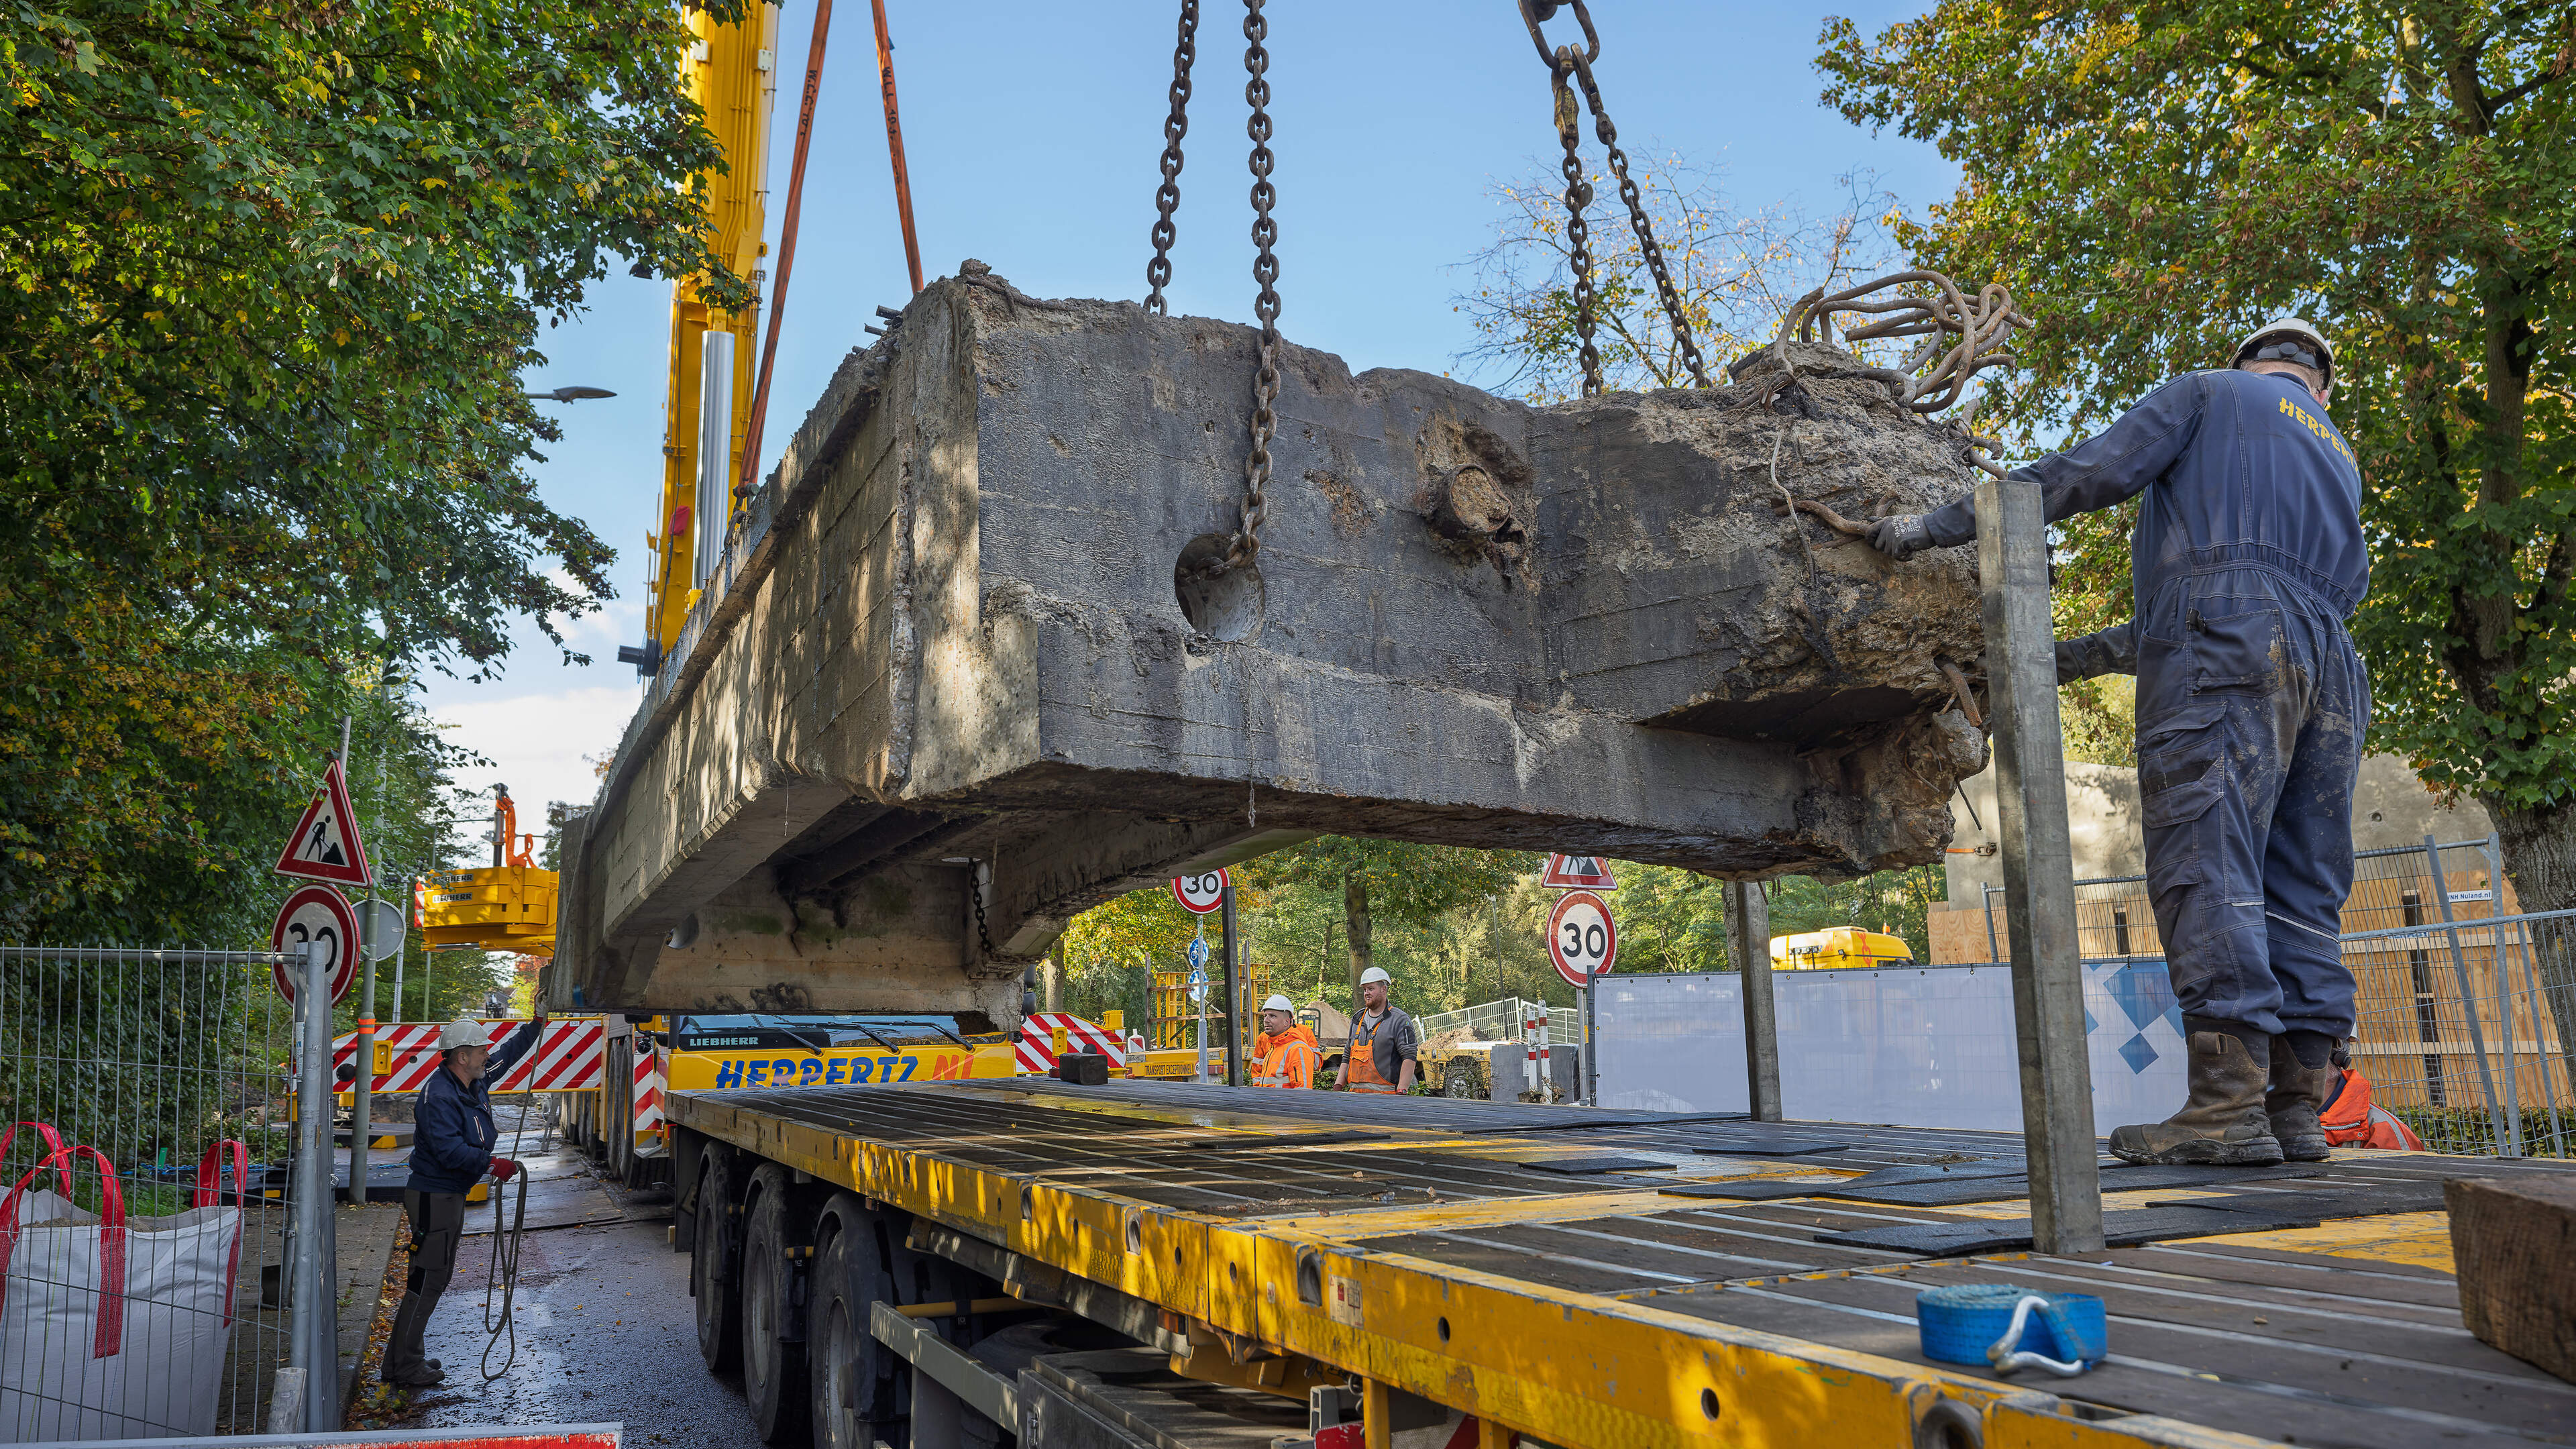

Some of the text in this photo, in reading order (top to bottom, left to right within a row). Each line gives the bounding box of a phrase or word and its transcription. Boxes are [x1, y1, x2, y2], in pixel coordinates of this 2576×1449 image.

[2279, 396, 2360, 478] HERPERTZ
[436, 873, 473, 883] BHERR
[1185, 873, 1219, 894] 30
[433, 893, 472, 902] LIEBHERR
[1562, 922, 1606, 959] 30
[690, 1036, 758, 1046] LIEBHERR
[715, 1054, 979, 1089] HERPERTZNL
[1144, 1063, 1192, 1076] TRANSPORT EXCEPTIONNEL
